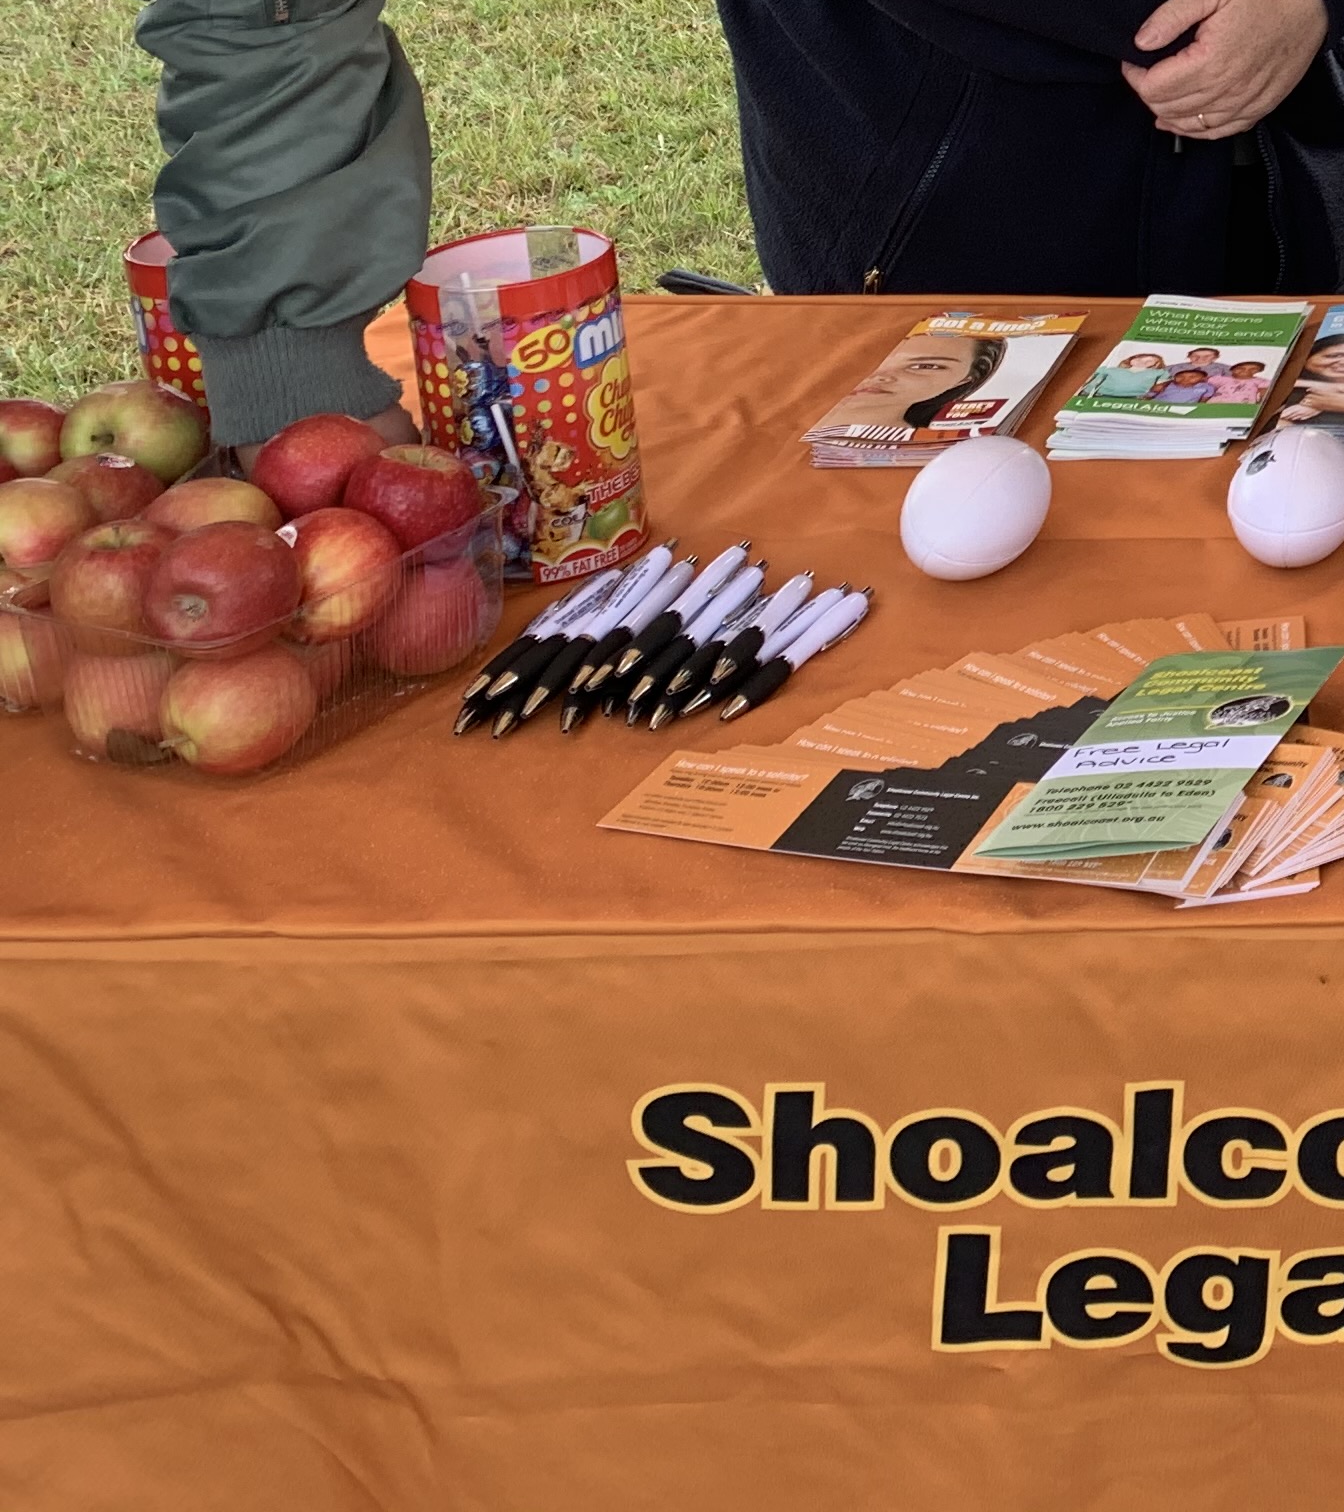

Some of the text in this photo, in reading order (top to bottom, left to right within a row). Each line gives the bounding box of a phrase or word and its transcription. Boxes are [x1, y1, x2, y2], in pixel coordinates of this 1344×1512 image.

[1145, 317, 1226, 329] when your
[1149, 309, 1263, 324] What happens
[928, 317, 1046, 333] Got a fine?
[1140, 324, 1284, 338] relationship ends?
[518, 328, 571, 370] 50
[551, 511, 592, 528] COLA
[542, 548, 619, 581] 99% FAT FREE
[1152, 666, 1264, 678] Shoalcoast
[1135, 681, 1267, 697] Legal Centre
[1143, 675, 1260, 688] Community
[1073, 738, 1231, 759] Free Legal
[674, 759, 694, 769] How
[719, 766, 747, 775] speak
[1076, 754, 1177, 769] Advice
[1046, 779, 1213, 795] Telephone 02 4422 9529
[1034, 789, 1217, 806] Freecall (Ulladulla to Eden)
[1028, 804, 1063, 814] 1800
[1066, 802, 1097, 811] 229
[1011, 815, 1166, 831] www.shoalcoast.org.au
